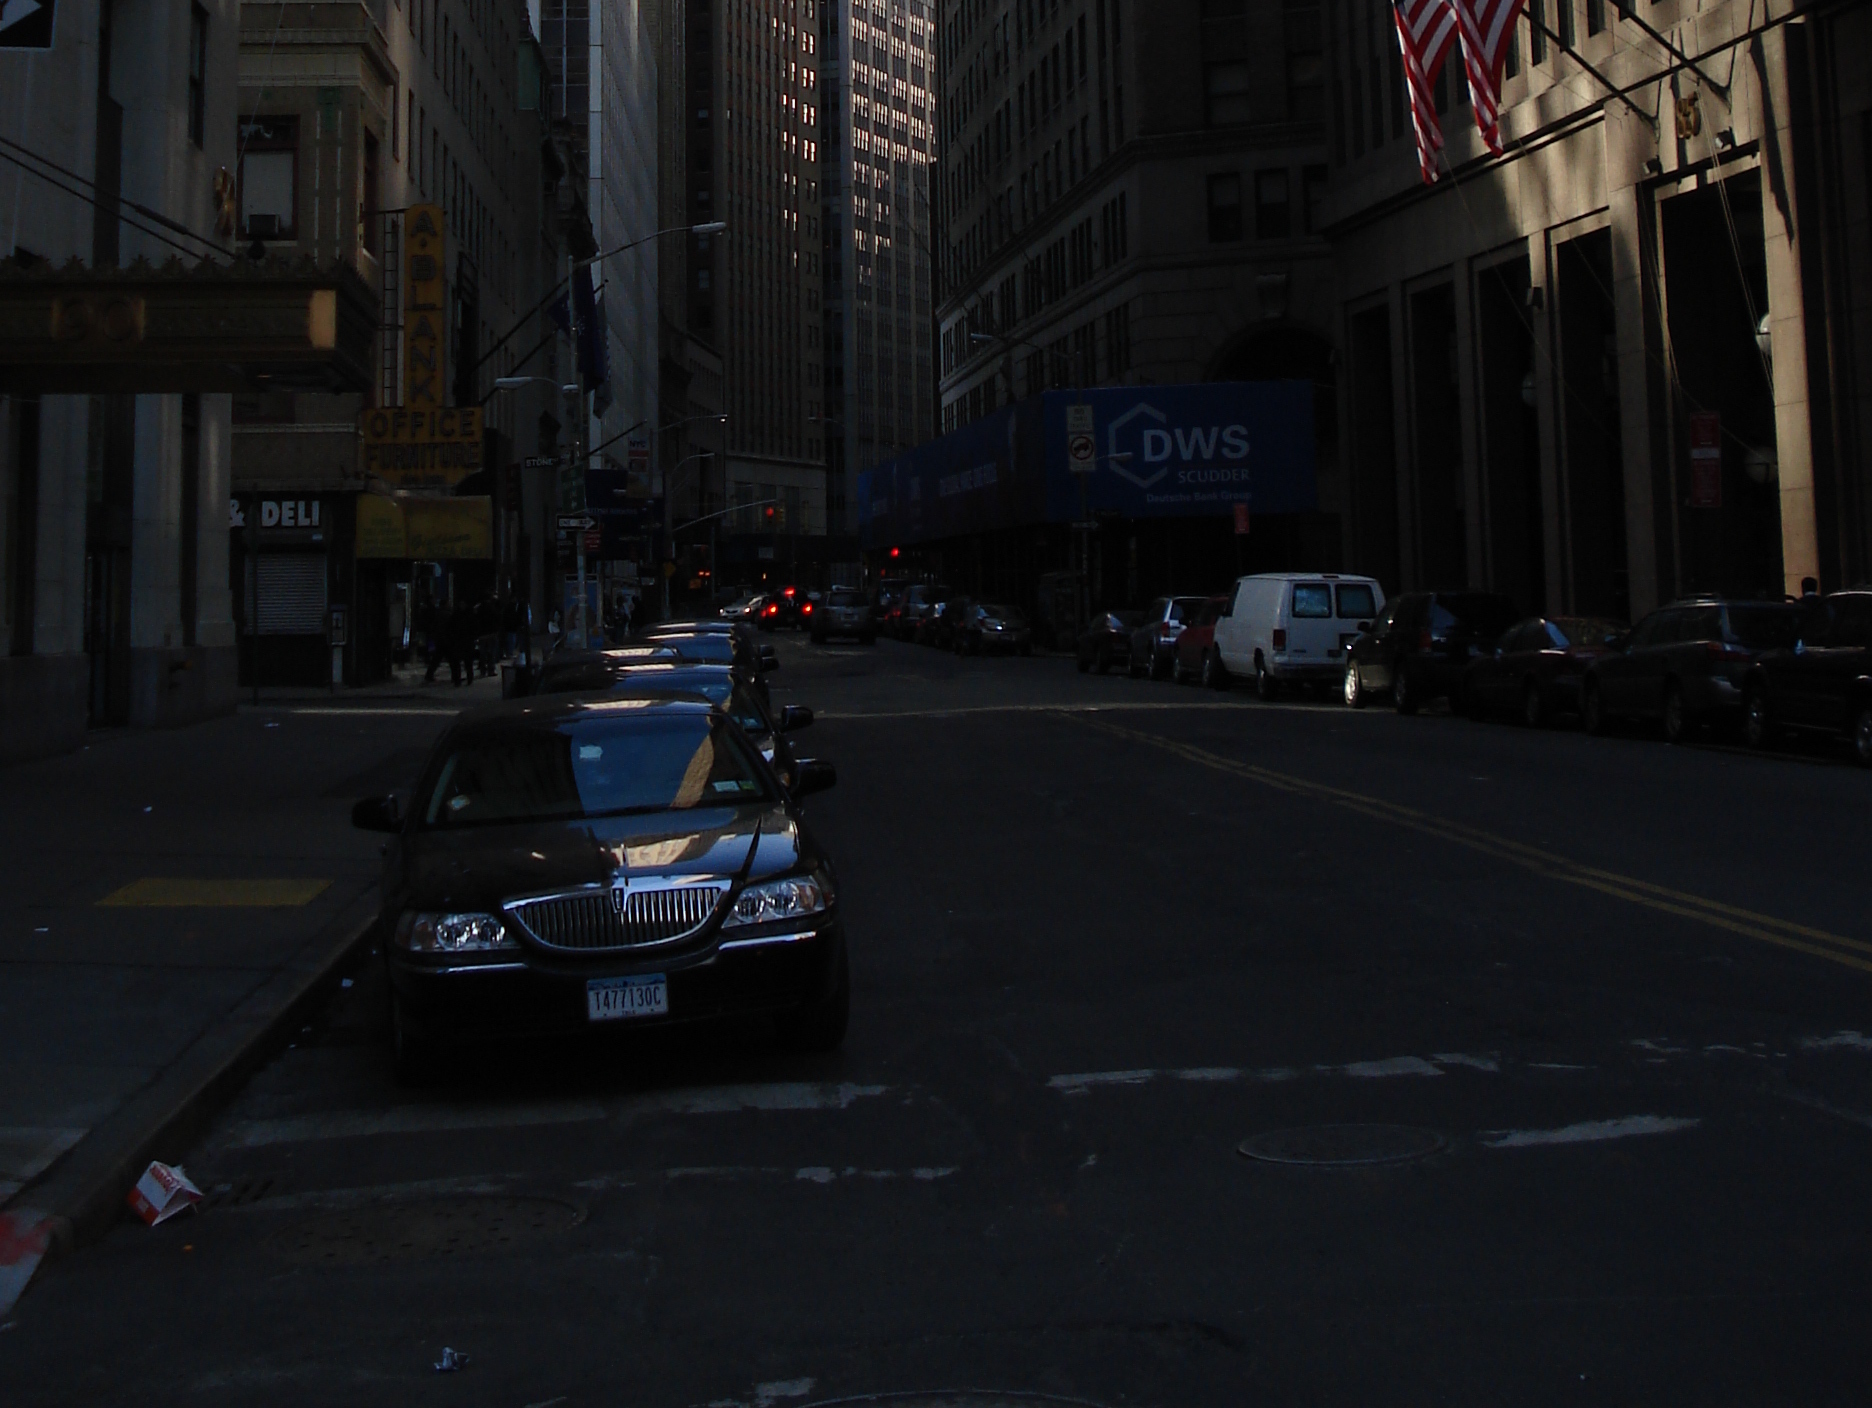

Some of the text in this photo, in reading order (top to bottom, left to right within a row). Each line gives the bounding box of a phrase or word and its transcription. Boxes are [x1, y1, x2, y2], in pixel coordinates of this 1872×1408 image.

[370, 410, 476, 438] OFFICE
[366, 442, 481, 470] FURNITURE
[1143, 424, 1251, 463] DWS
[1178, 468, 1250, 484] SCUDDER
[1146, 491, 1251, 503] Deutsche Bank Group
[261, 500, 320, 527] DELI
[595, 985, 661, 1011] T477130C
